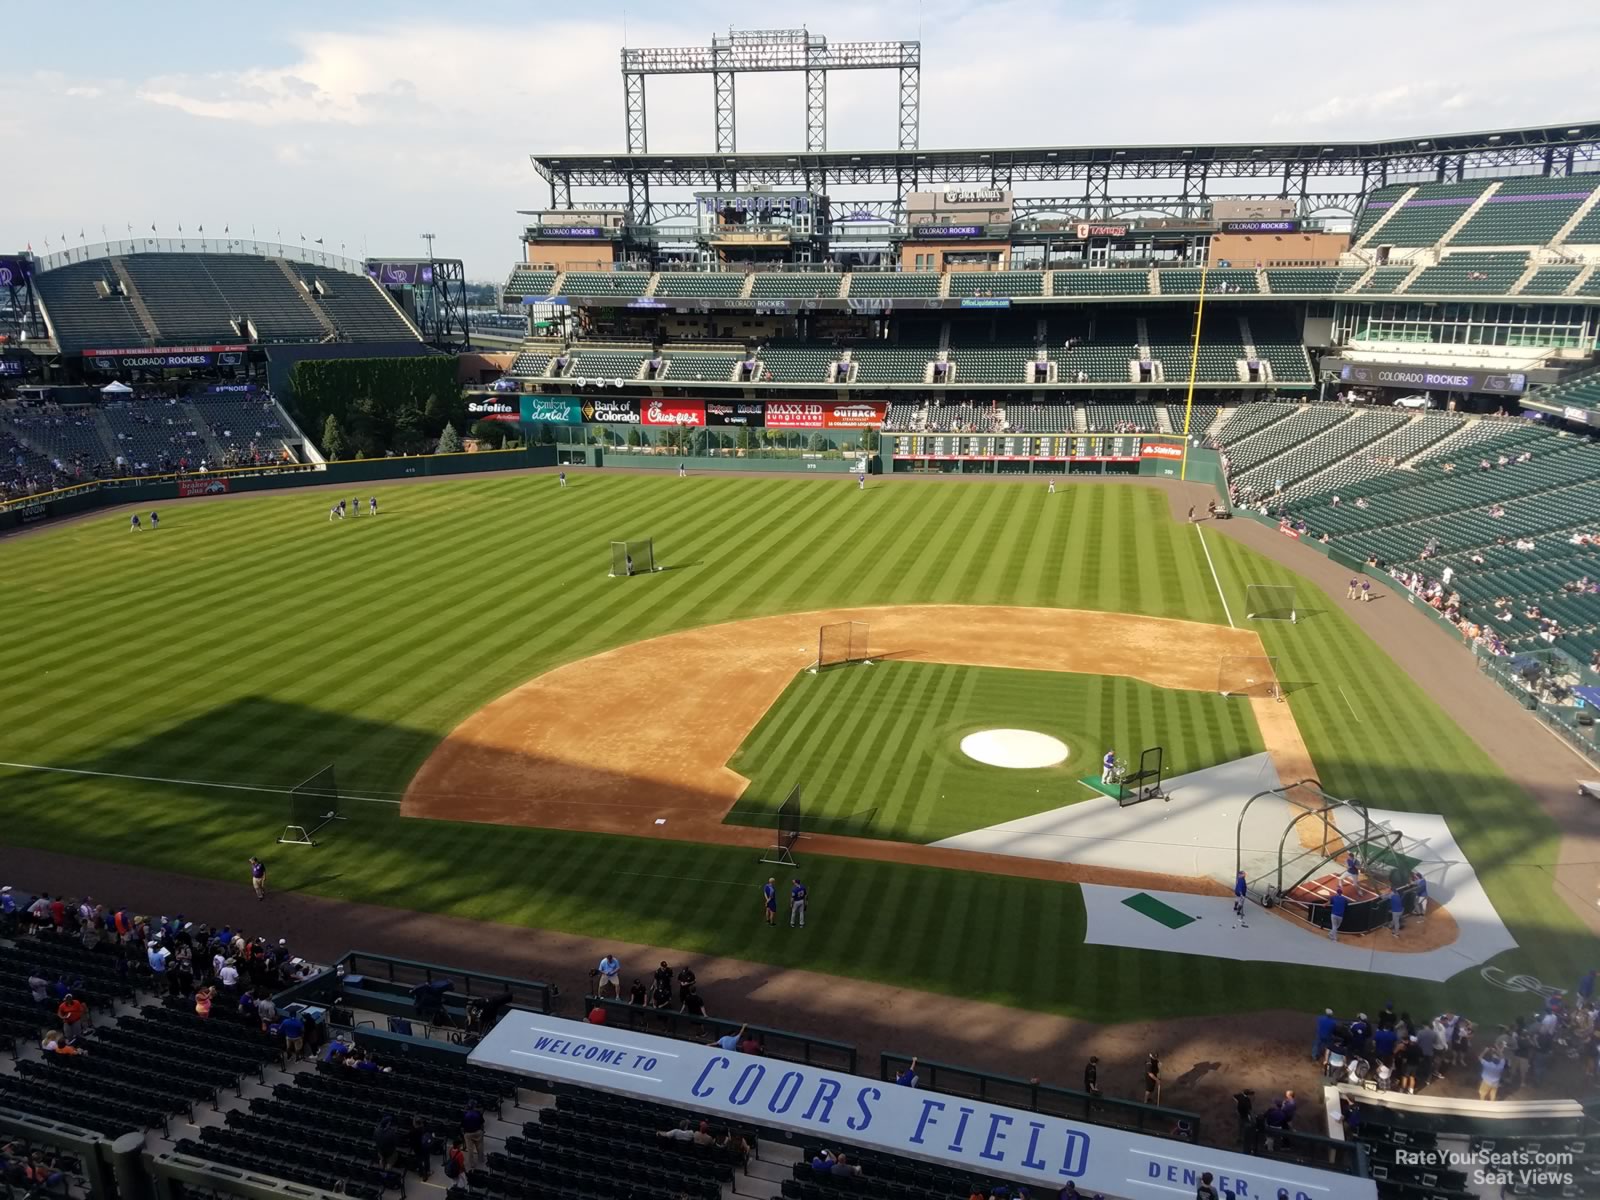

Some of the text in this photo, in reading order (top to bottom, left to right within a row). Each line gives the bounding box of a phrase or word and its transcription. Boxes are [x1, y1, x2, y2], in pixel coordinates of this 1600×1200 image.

[918, 226, 976, 235] COLORADO ROCKIES
[1228, 222, 1288, 230] COLORADO ROCKIES
[542, 228, 570, 236] COLORADO
[724, 300, 785, 308] COLORADO ROCKIES
[122, 356, 206, 366] COLORADO ROCKIES
[1378, 371, 1469, 386] COLORADO ROCKIES
[468, 402, 512, 412] Safelite
[532, 398, 566, 409] Comfort
[594, 400, 630, 411] Bank of
[532, 407, 570, 420] dental
[768, 404, 822, 414] MAXX HD
[595, 411, 639, 422] Colorado
[533, 1036, 627, 1066] WELCOME
[633, 1054, 658, 1072] TO
[690, 1056, 882, 1132] COORS
[909, 1099, 1091, 1178] FIELD
[1148, 1161, 1260, 1200] DENER,
